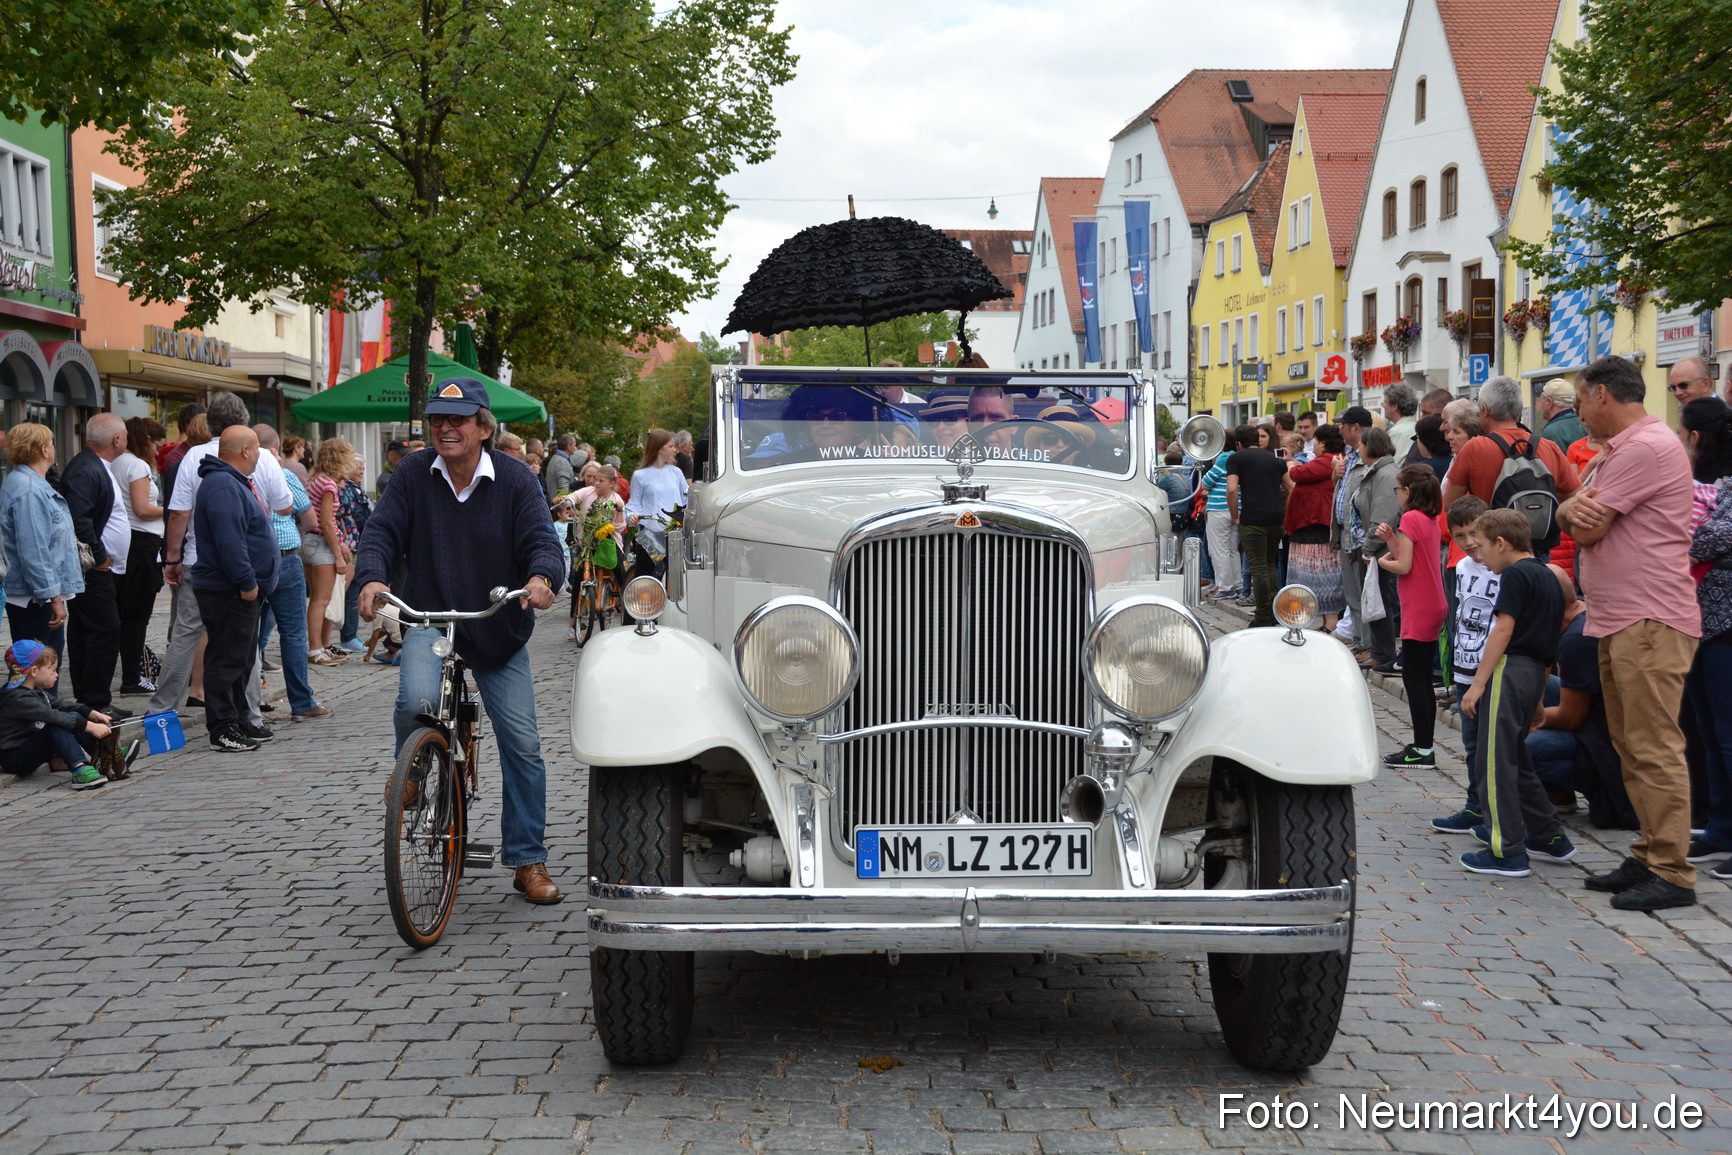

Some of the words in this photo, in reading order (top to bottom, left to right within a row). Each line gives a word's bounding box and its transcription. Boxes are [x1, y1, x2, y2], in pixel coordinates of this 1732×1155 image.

[1224, 294, 1242, 313] HOTEL
[151, 325, 179, 358] LEDER
[926, 703, 1015, 716] ZEPPELIN
[879, 836, 922, 872] NM
[947, 836, 990, 872] LZ
[863, 859, 872, 870] D
